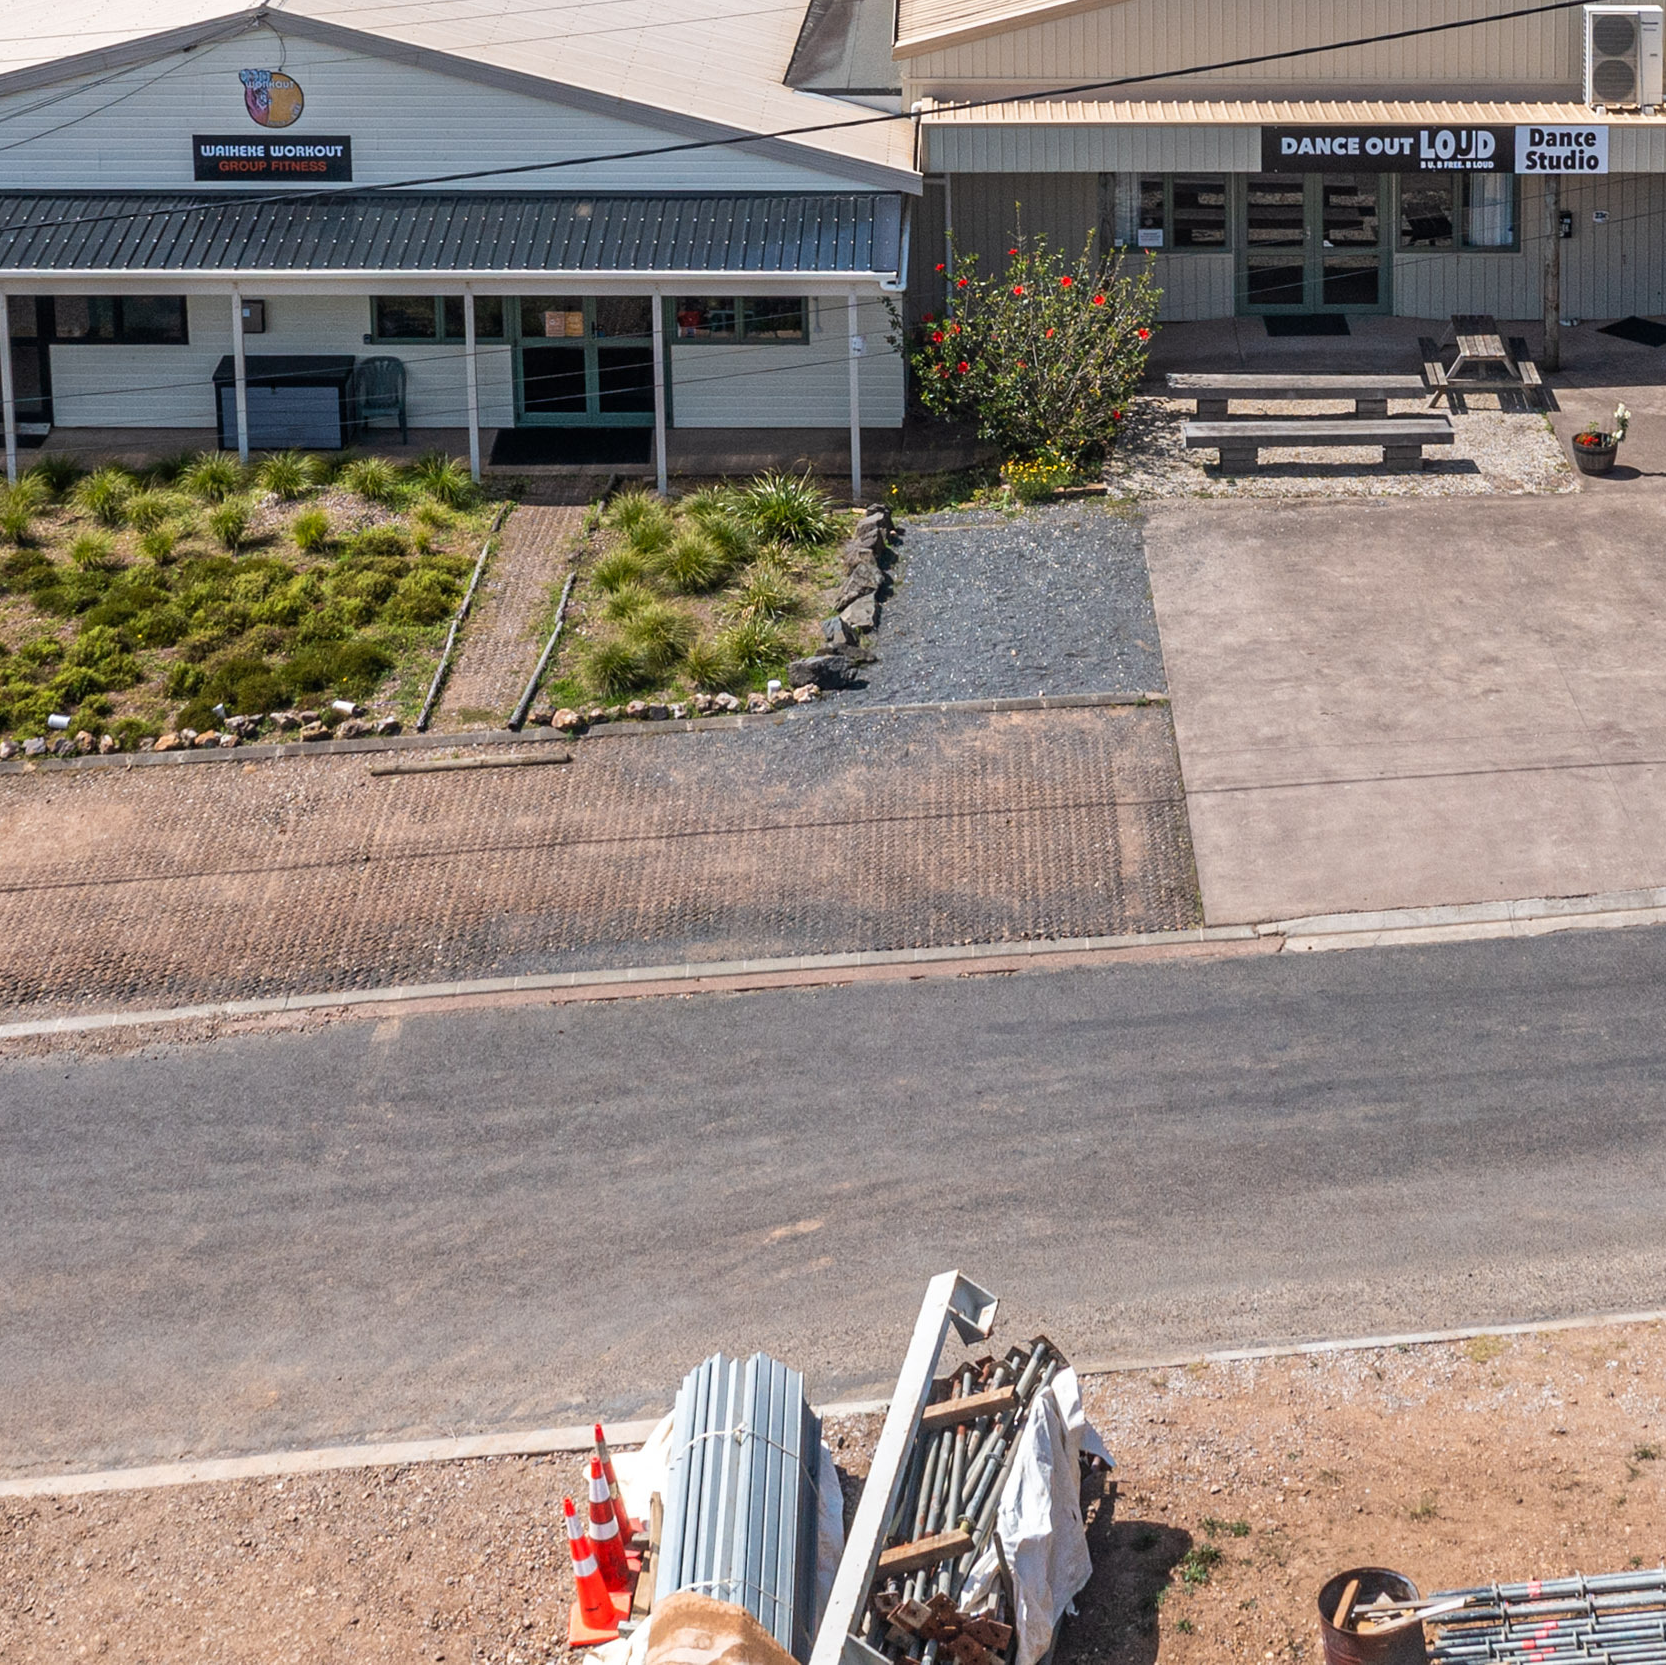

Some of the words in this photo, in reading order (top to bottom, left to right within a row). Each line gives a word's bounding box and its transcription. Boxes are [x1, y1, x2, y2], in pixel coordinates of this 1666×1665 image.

[1281, 137, 1359, 155] DANCE
[1365, 137, 1414, 154] OUT
[1420, 130, 1496, 160] LOUD
[1529, 128, 1597, 148] Dance
[201, 145, 265, 156] WAIHEKE
[270, 145, 343, 156] WORKOUT
[1525, 150, 1599, 171] Studio
[219, 160, 267, 171] GROUP
[271, 160, 327, 171] FITNESS
